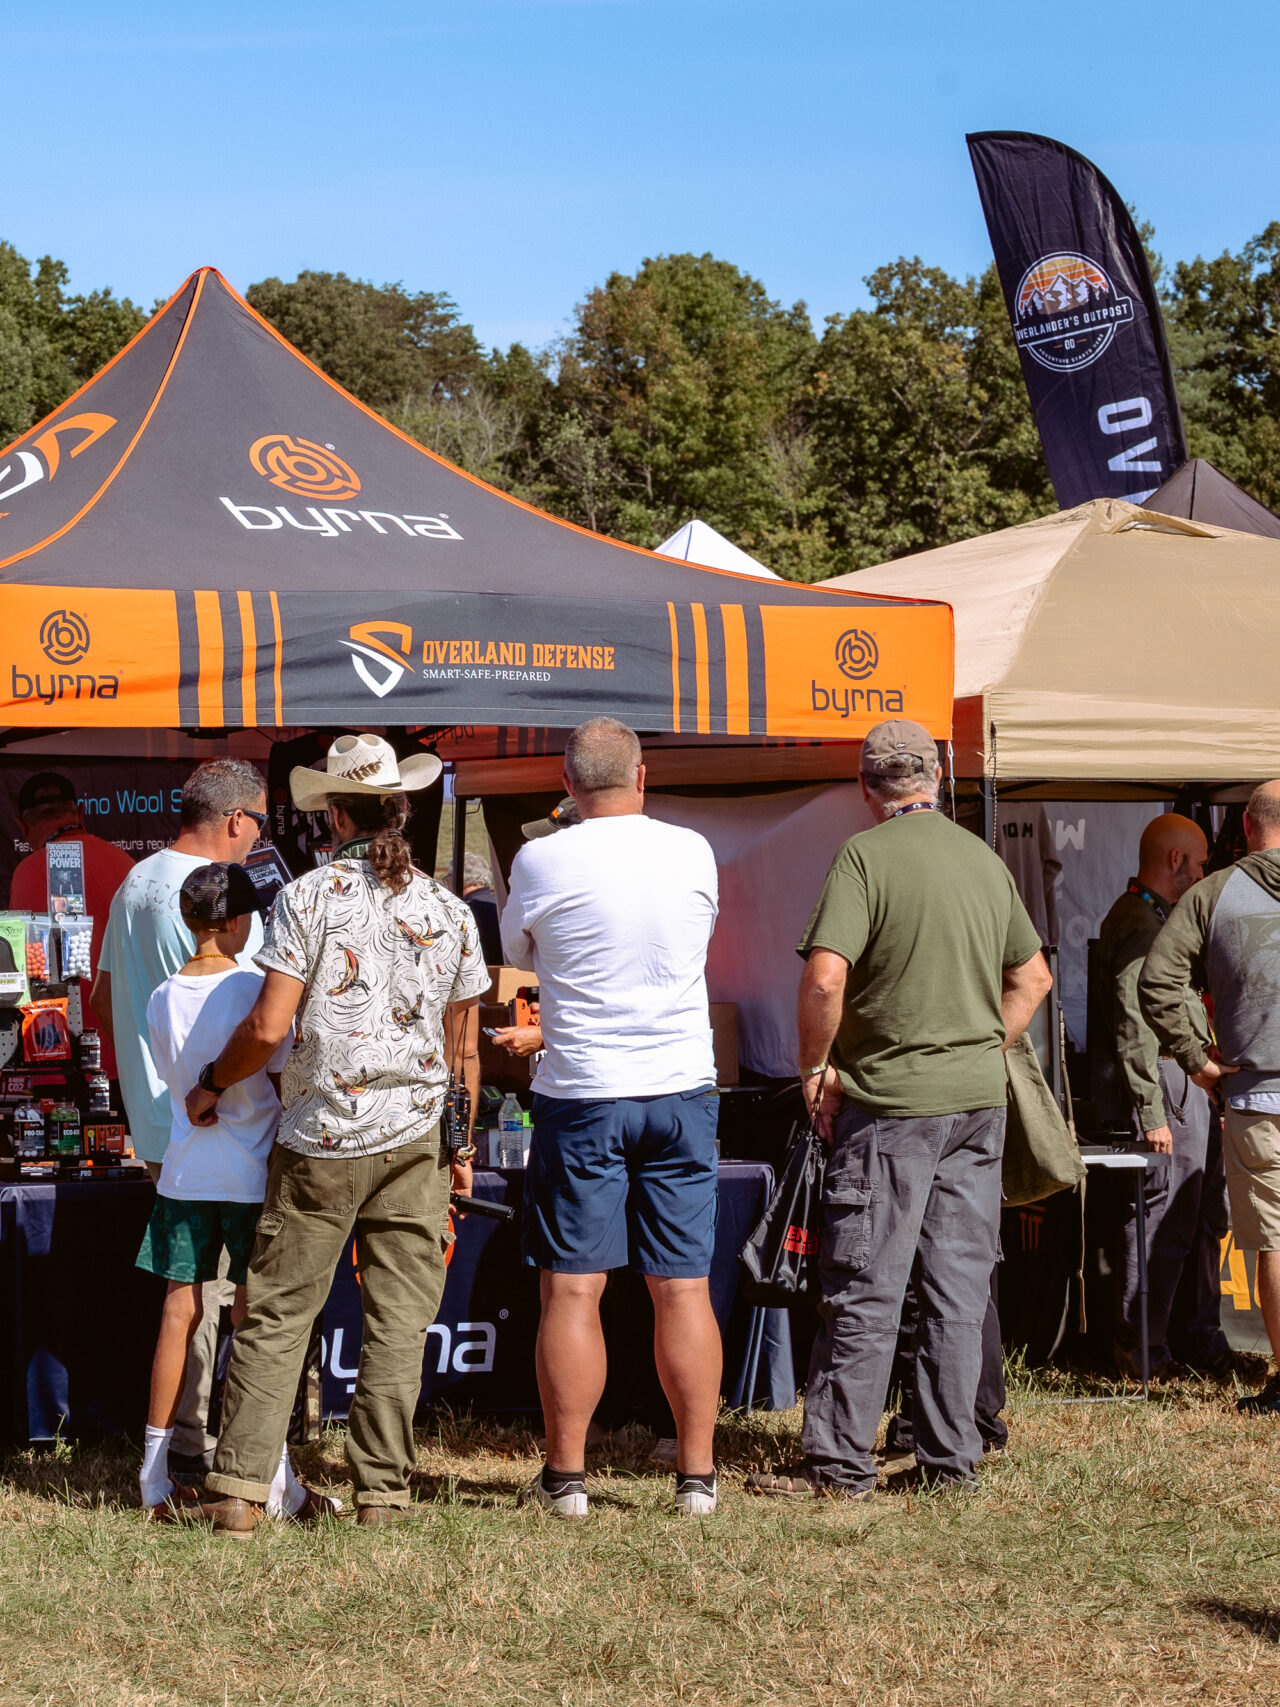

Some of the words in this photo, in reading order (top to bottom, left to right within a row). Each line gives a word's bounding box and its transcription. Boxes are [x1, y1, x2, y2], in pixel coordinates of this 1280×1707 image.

[1083, 303, 1128, 324] OUTPOST
[218, 496, 465, 541] byrna
[422, 640, 527, 668] OVERLAND
[532, 643, 616, 671] DEFENSE
[11, 664, 119, 706] byrna
[422, 668, 551, 682] SMART-SAFE-PREPARED
[811, 679, 905, 718] byrna
[116, 789, 163, 814] Wool
[276, 805, 286, 835] byrna
[49, 850, 80, 858] STOPPING
[49, 858, 81, 869] POWER
